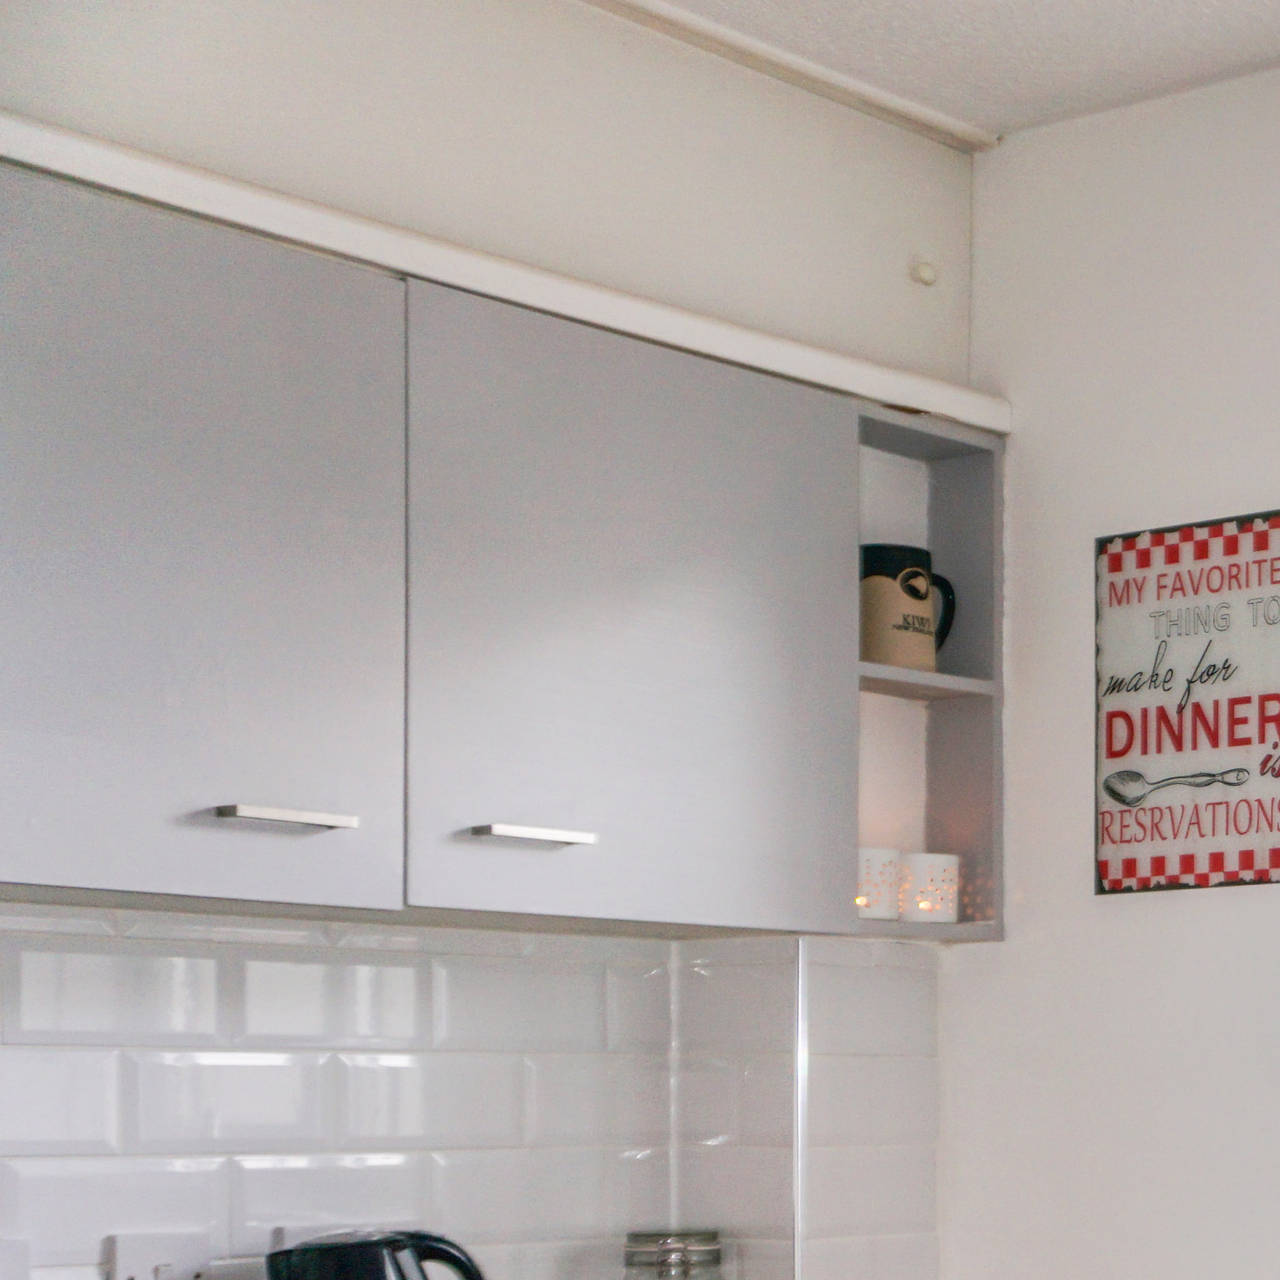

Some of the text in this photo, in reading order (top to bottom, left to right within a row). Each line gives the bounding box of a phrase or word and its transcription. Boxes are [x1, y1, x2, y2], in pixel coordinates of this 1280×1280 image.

[1108, 575, 1147, 608] MY
[1150, 602, 1231, 639] THING
[1102, 640, 1238, 714] make for
